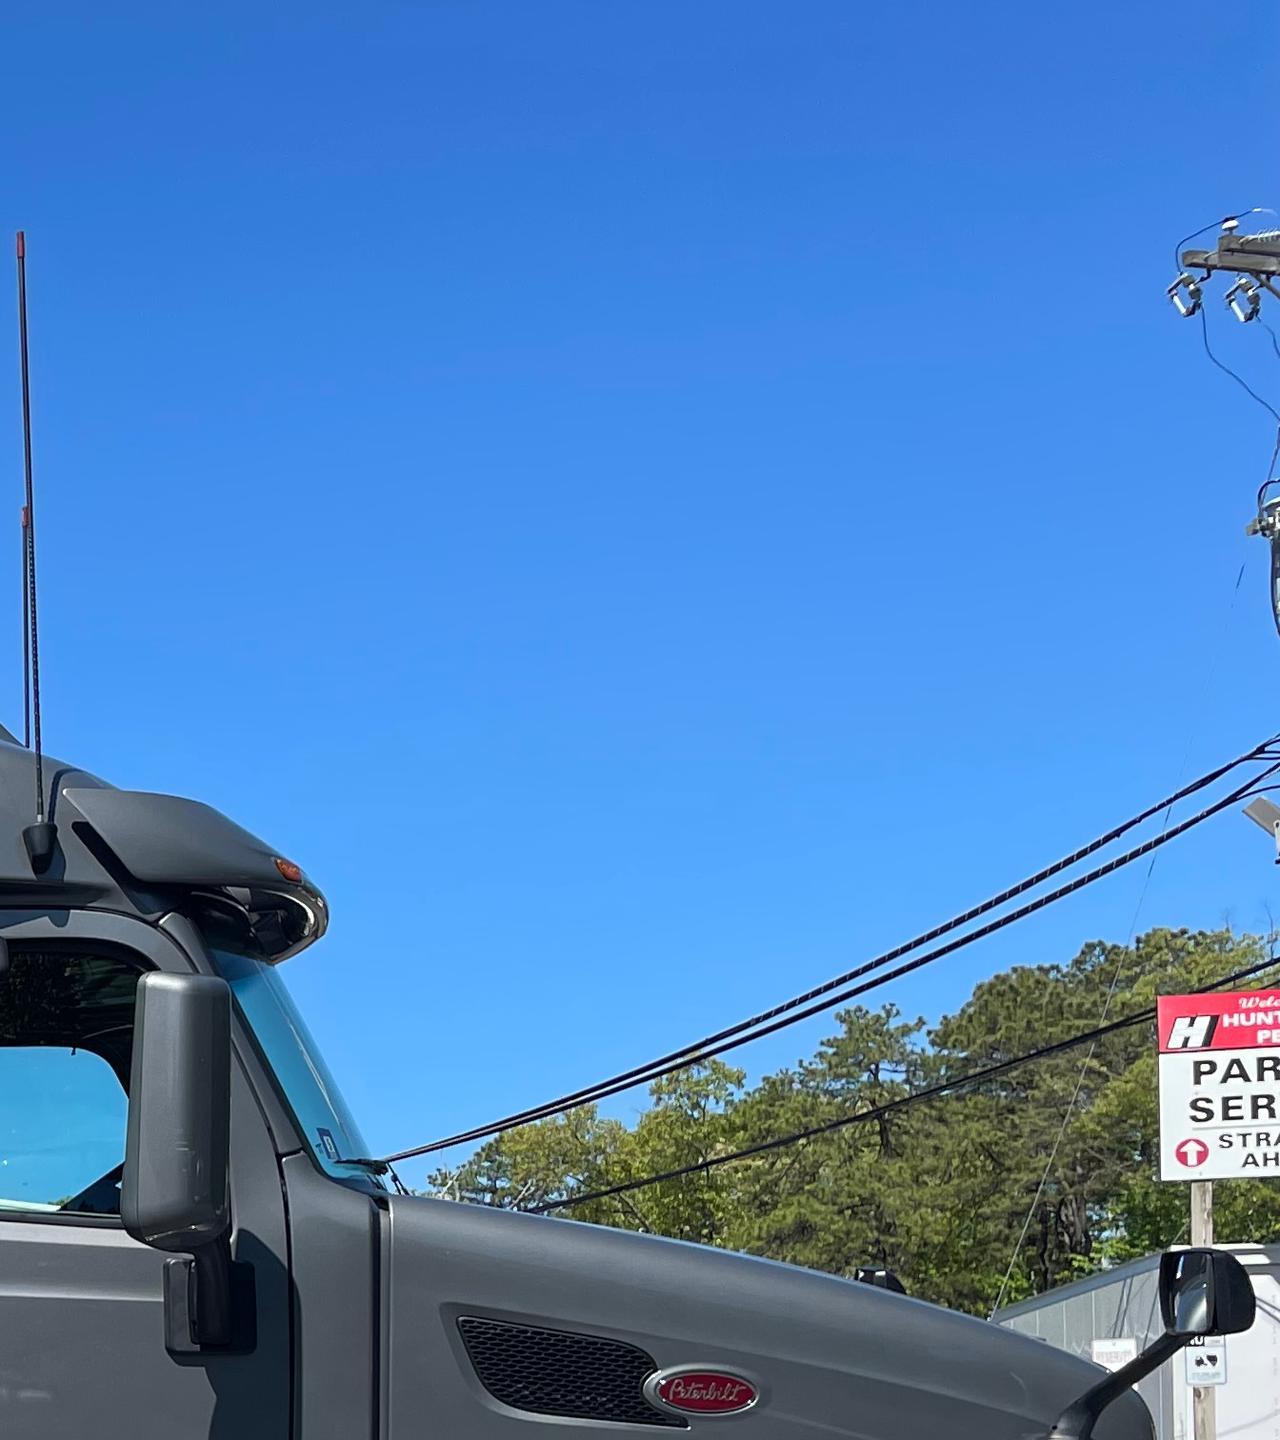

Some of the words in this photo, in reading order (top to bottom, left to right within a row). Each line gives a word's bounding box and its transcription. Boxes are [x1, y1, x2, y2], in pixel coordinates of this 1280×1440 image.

[1192, 1056, 1280, 1086] PAR
[1189, 1093, 1276, 1123] SER
[1241, 1151, 1280, 1168] AH
[668, 1378, 747, 1402] Peterbilt
